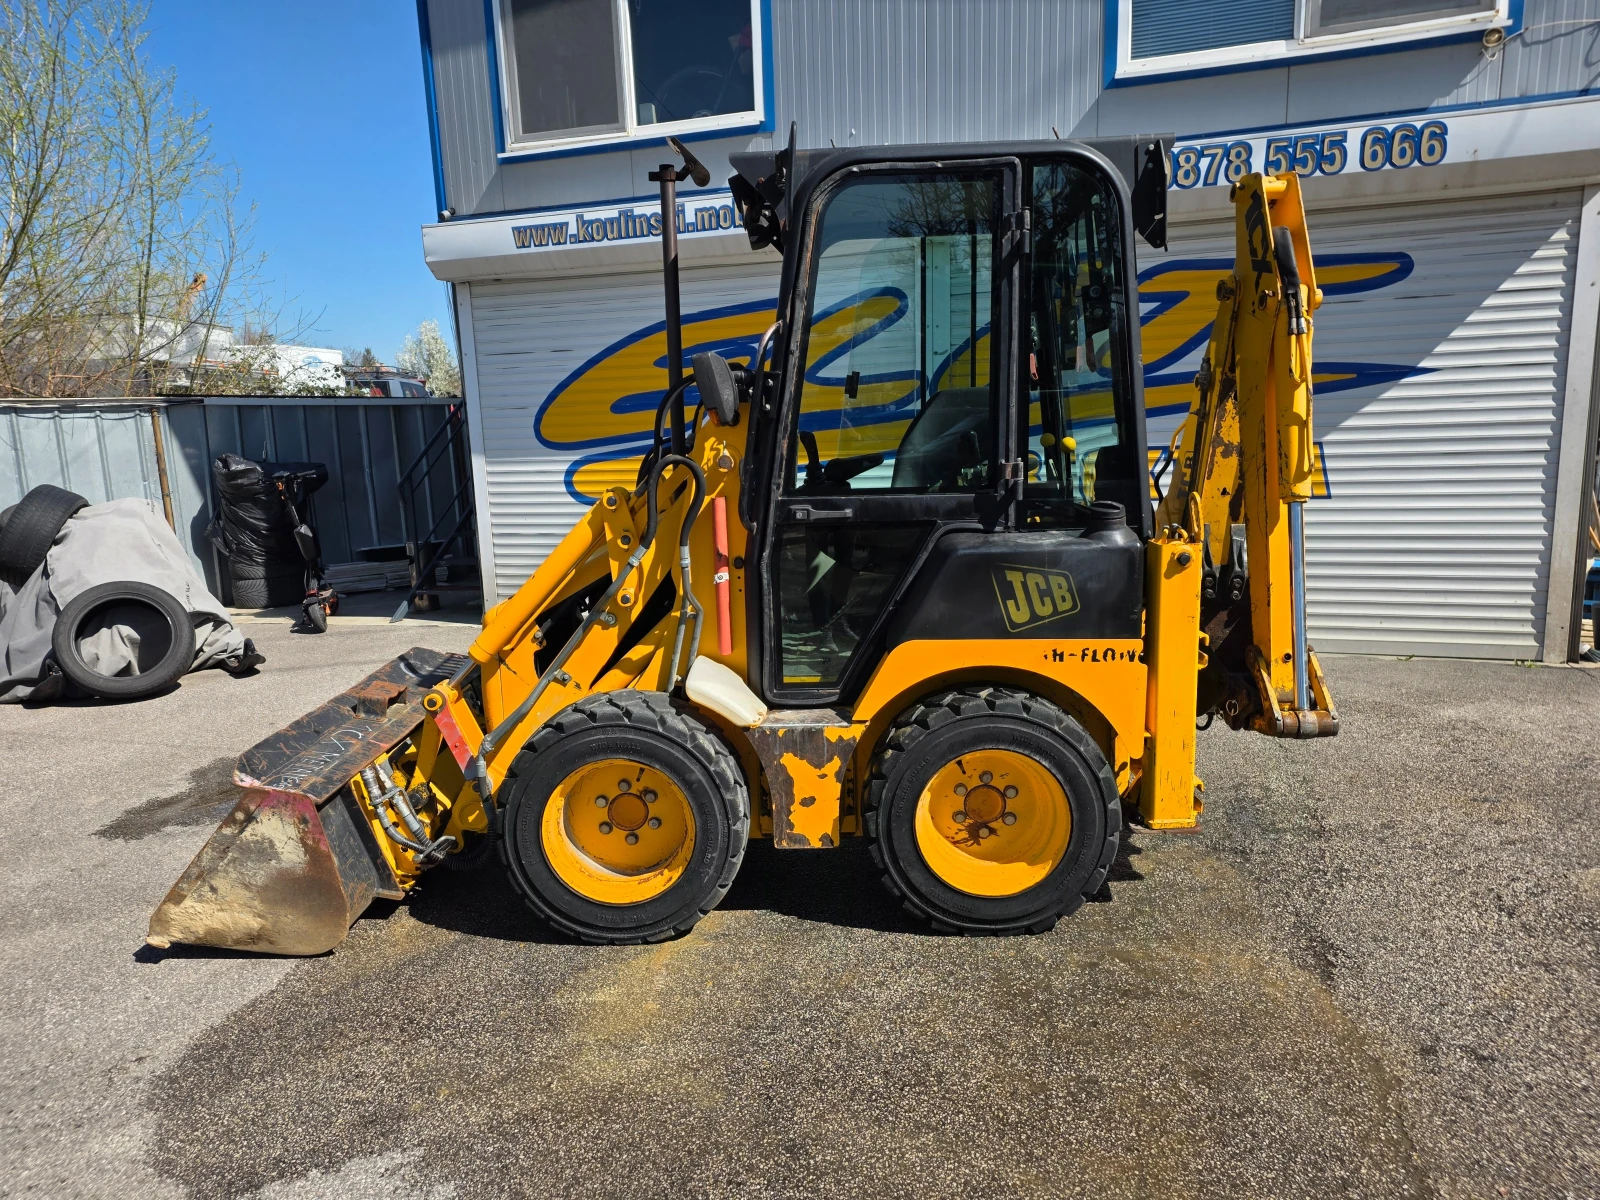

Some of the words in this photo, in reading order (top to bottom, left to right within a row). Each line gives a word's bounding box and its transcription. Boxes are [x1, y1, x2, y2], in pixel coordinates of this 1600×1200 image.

[1264, 130, 1348, 178] 555
[1359, 119, 1449, 172] 666
[511, 197, 744, 249] www.koulinsi.mob
[1005, 569, 1074, 624] JCB
